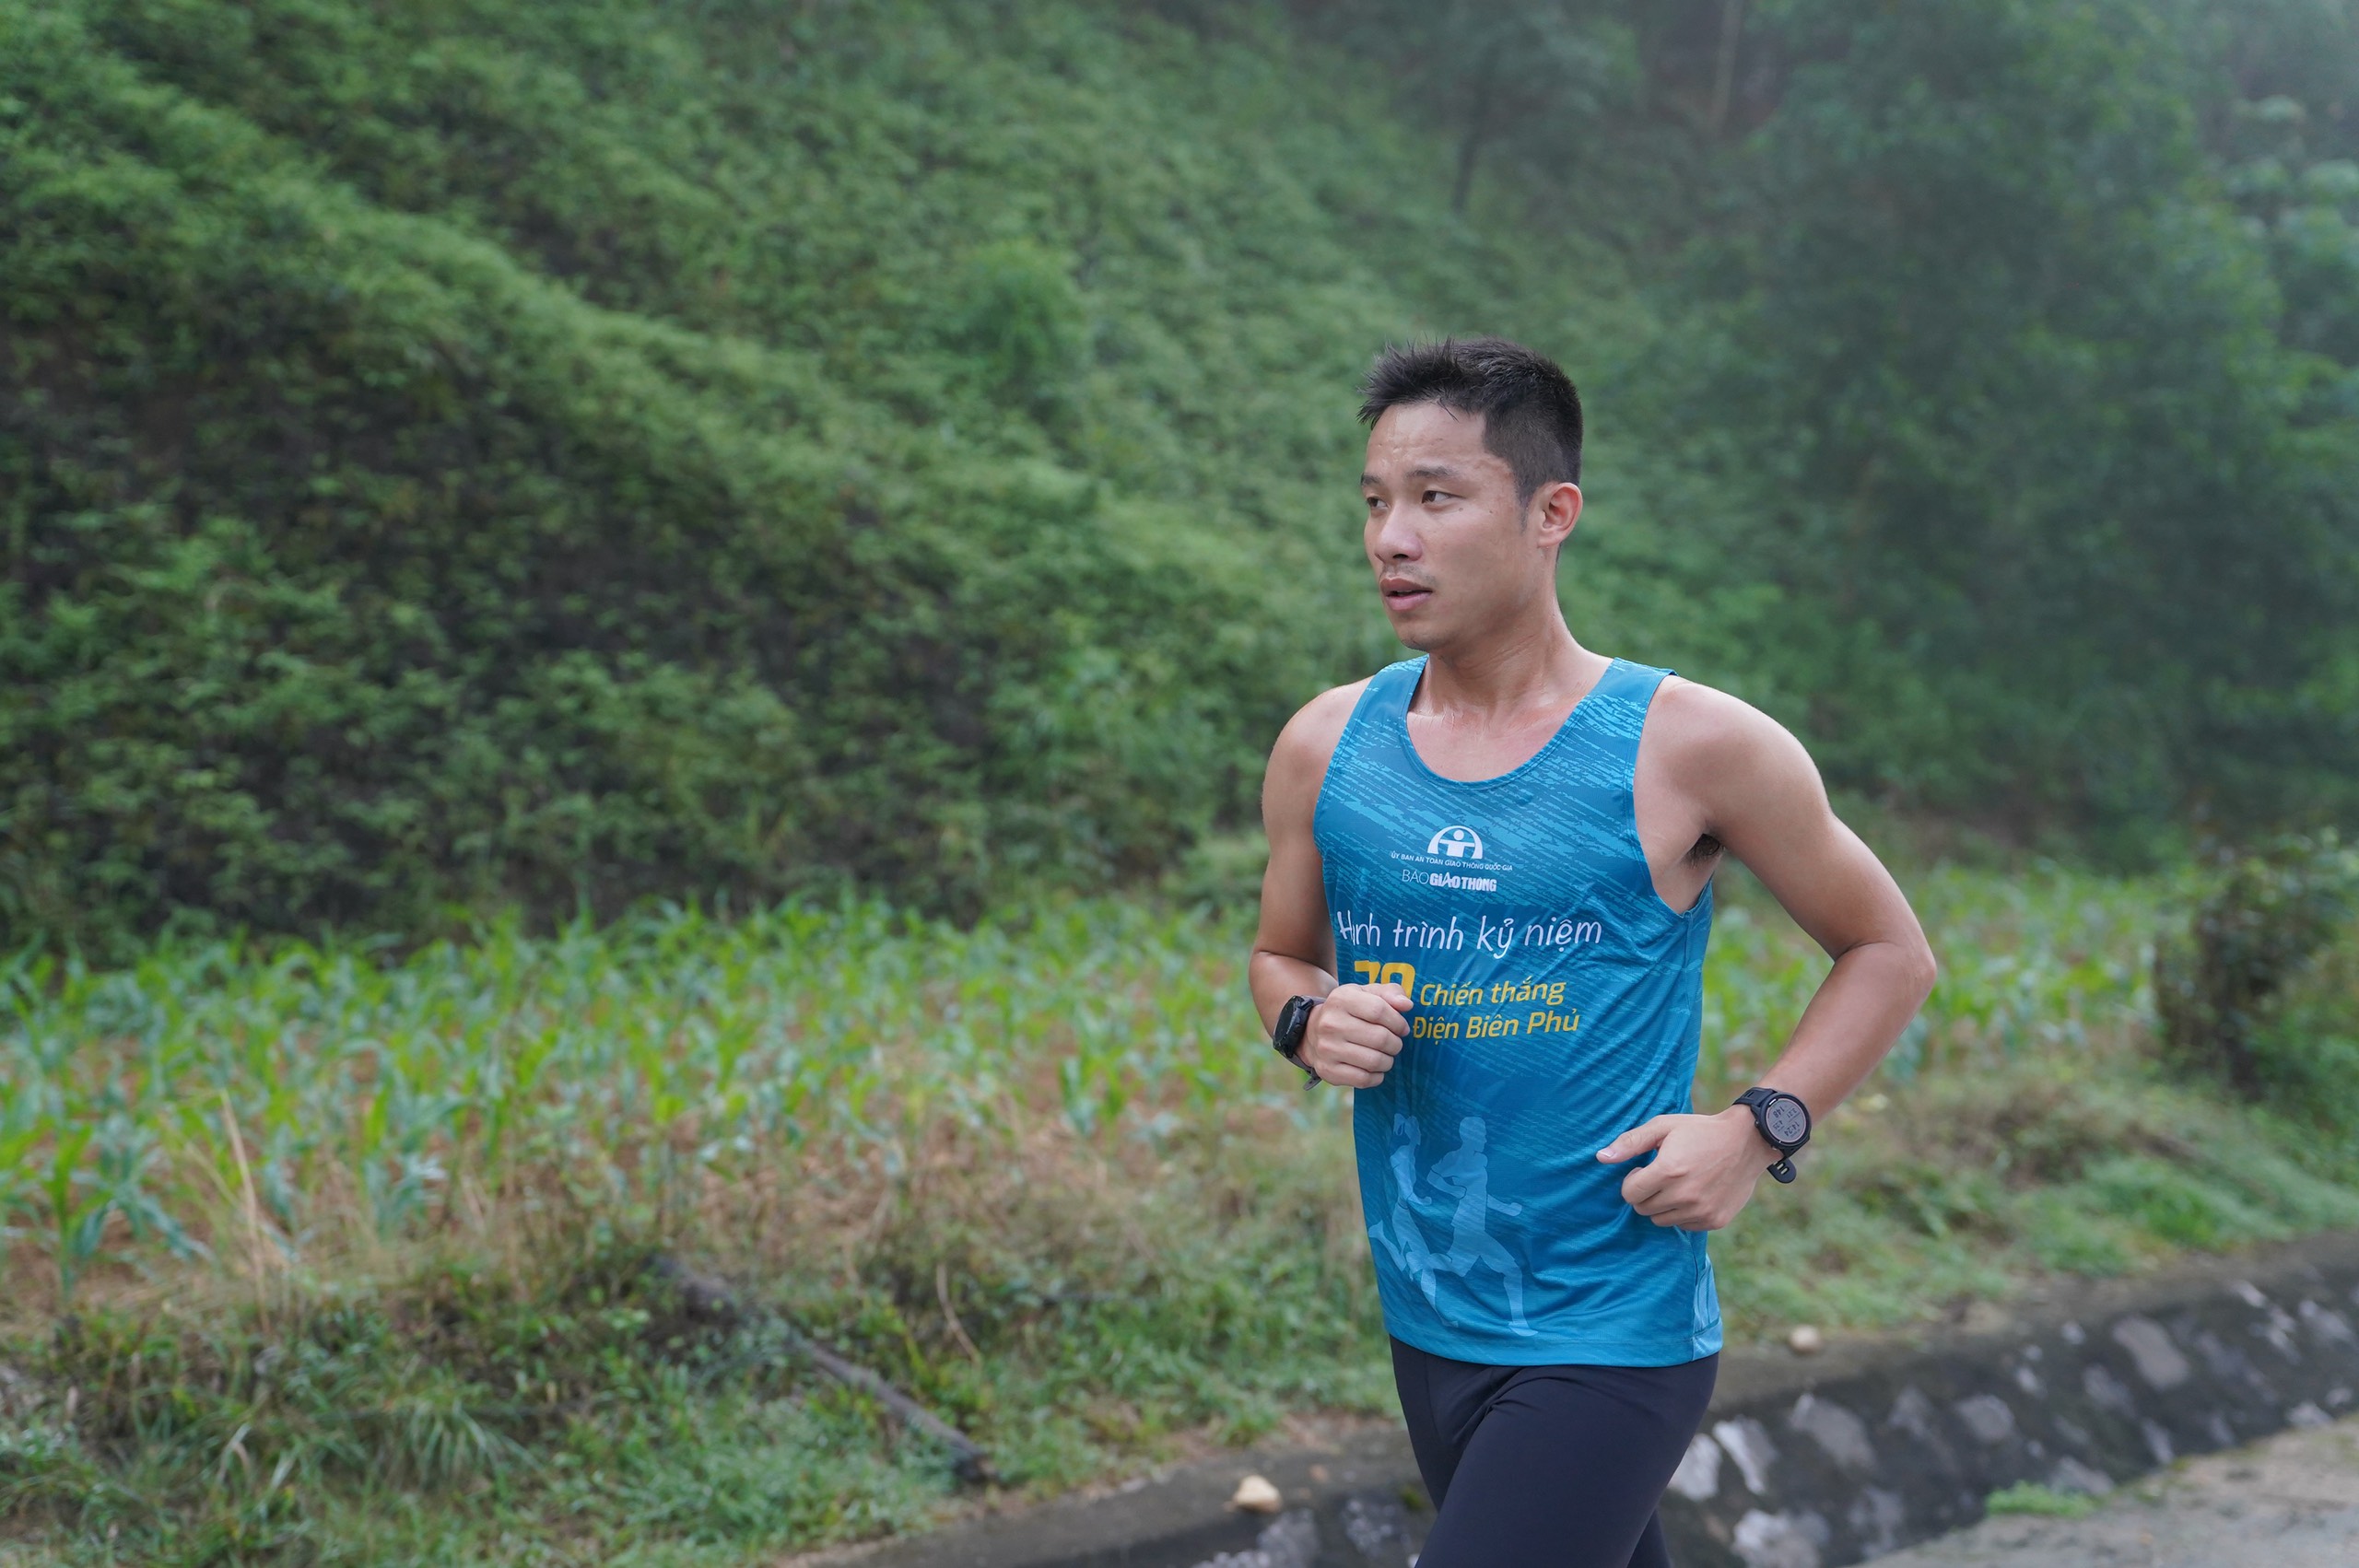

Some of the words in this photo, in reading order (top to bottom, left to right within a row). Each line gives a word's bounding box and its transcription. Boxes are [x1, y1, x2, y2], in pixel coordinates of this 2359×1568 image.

[1401, 853, 1414, 861] BAN
[1414, 855, 1425, 863] AN
[1426, 856, 1444, 865] TOÀN
[1444, 860, 1461, 868] GIAO
[1485, 862, 1501, 871] QUỐC
[1392, 916, 1464, 951] trình
[1476, 915, 1515, 959] kỷ
[1523, 917, 1602, 953] niệm
[1420, 980, 1484, 1006] Chiến
[1490, 975, 1567, 1006] thắng
[1413, 1016, 1460, 1046] Điện
[1465, 1014, 1520, 1039] Biên
[1526, 1008, 1580, 1035] Phủ
